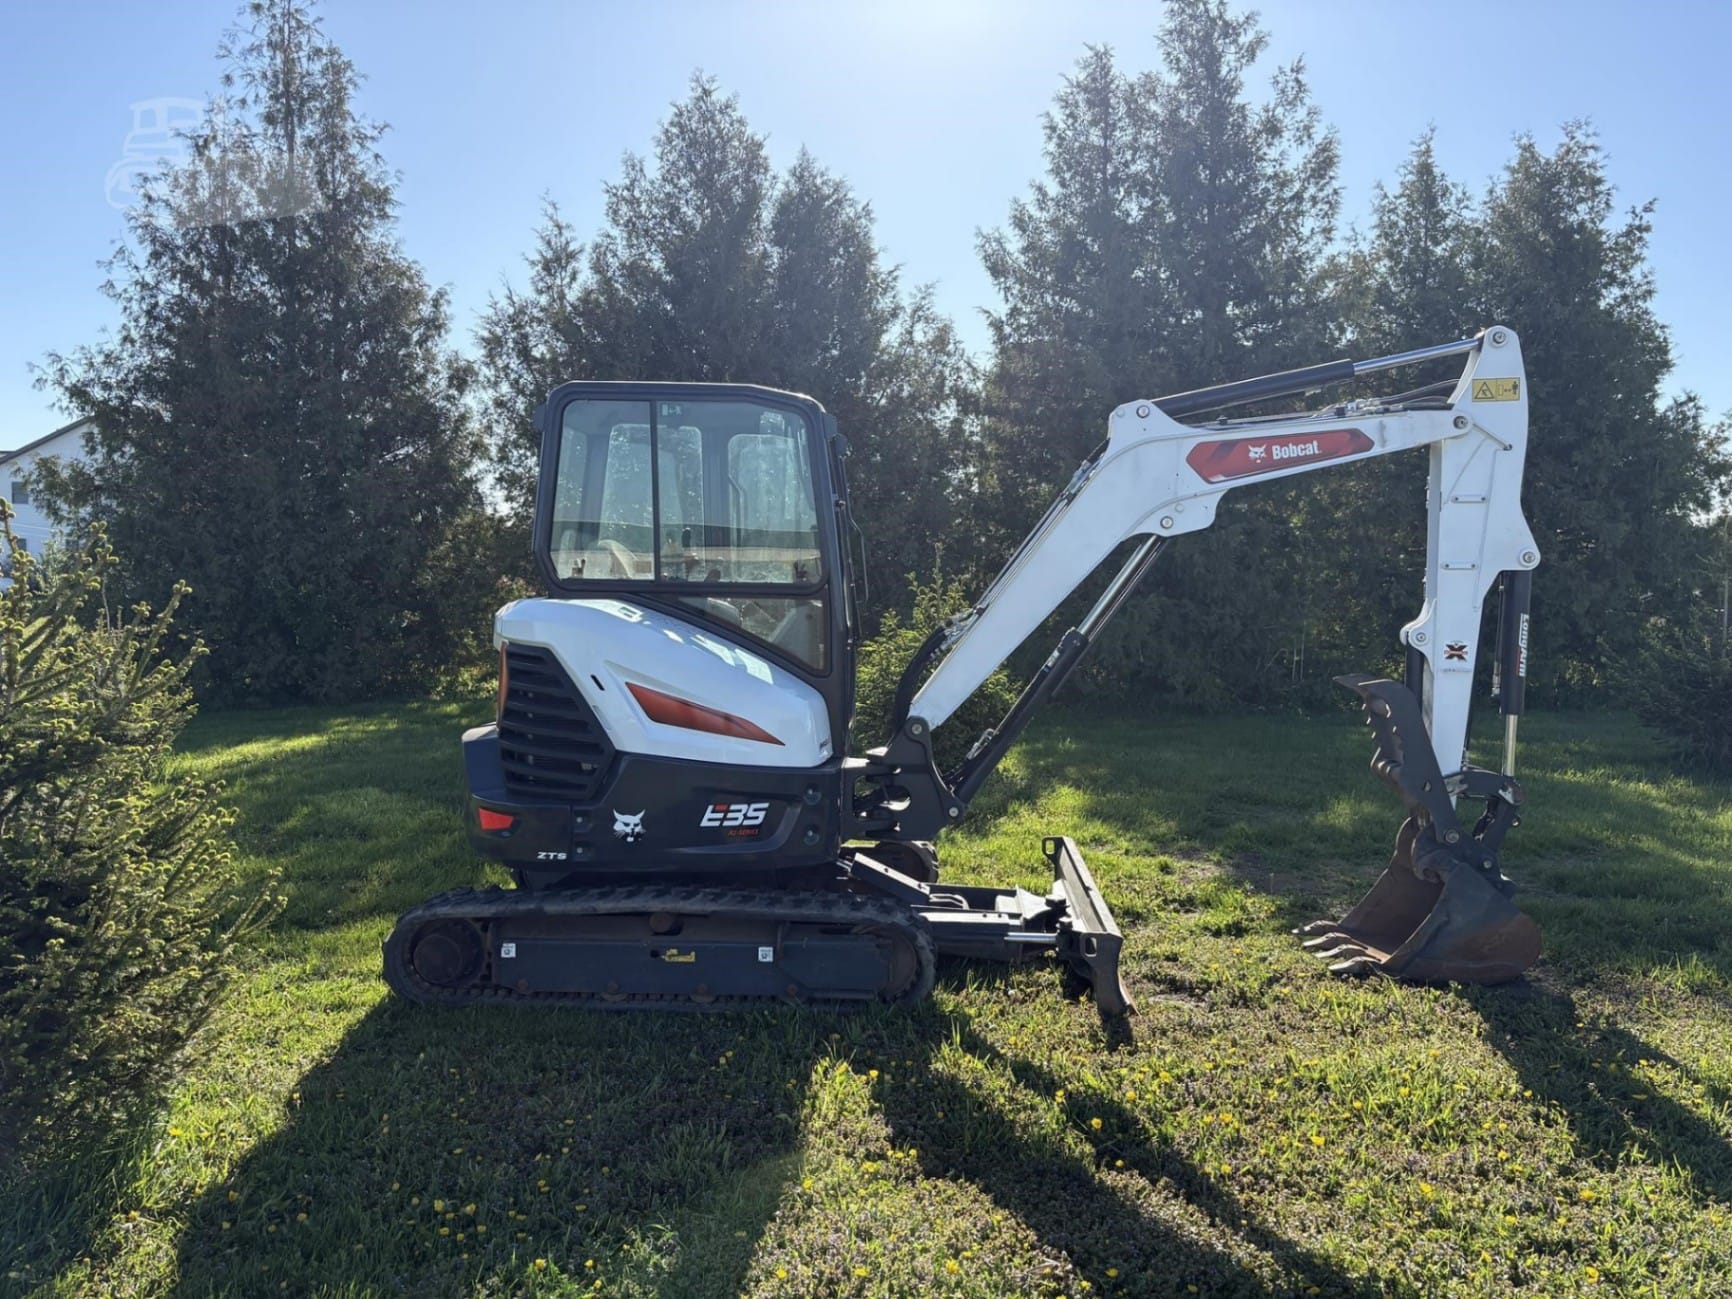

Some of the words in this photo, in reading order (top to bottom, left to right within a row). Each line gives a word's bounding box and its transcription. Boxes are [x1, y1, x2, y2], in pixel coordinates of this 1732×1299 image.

[1271, 440, 1320, 460] Bobcat
[700, 802, 770, 827] E35
[537, 851, 567, 860] ZTS
